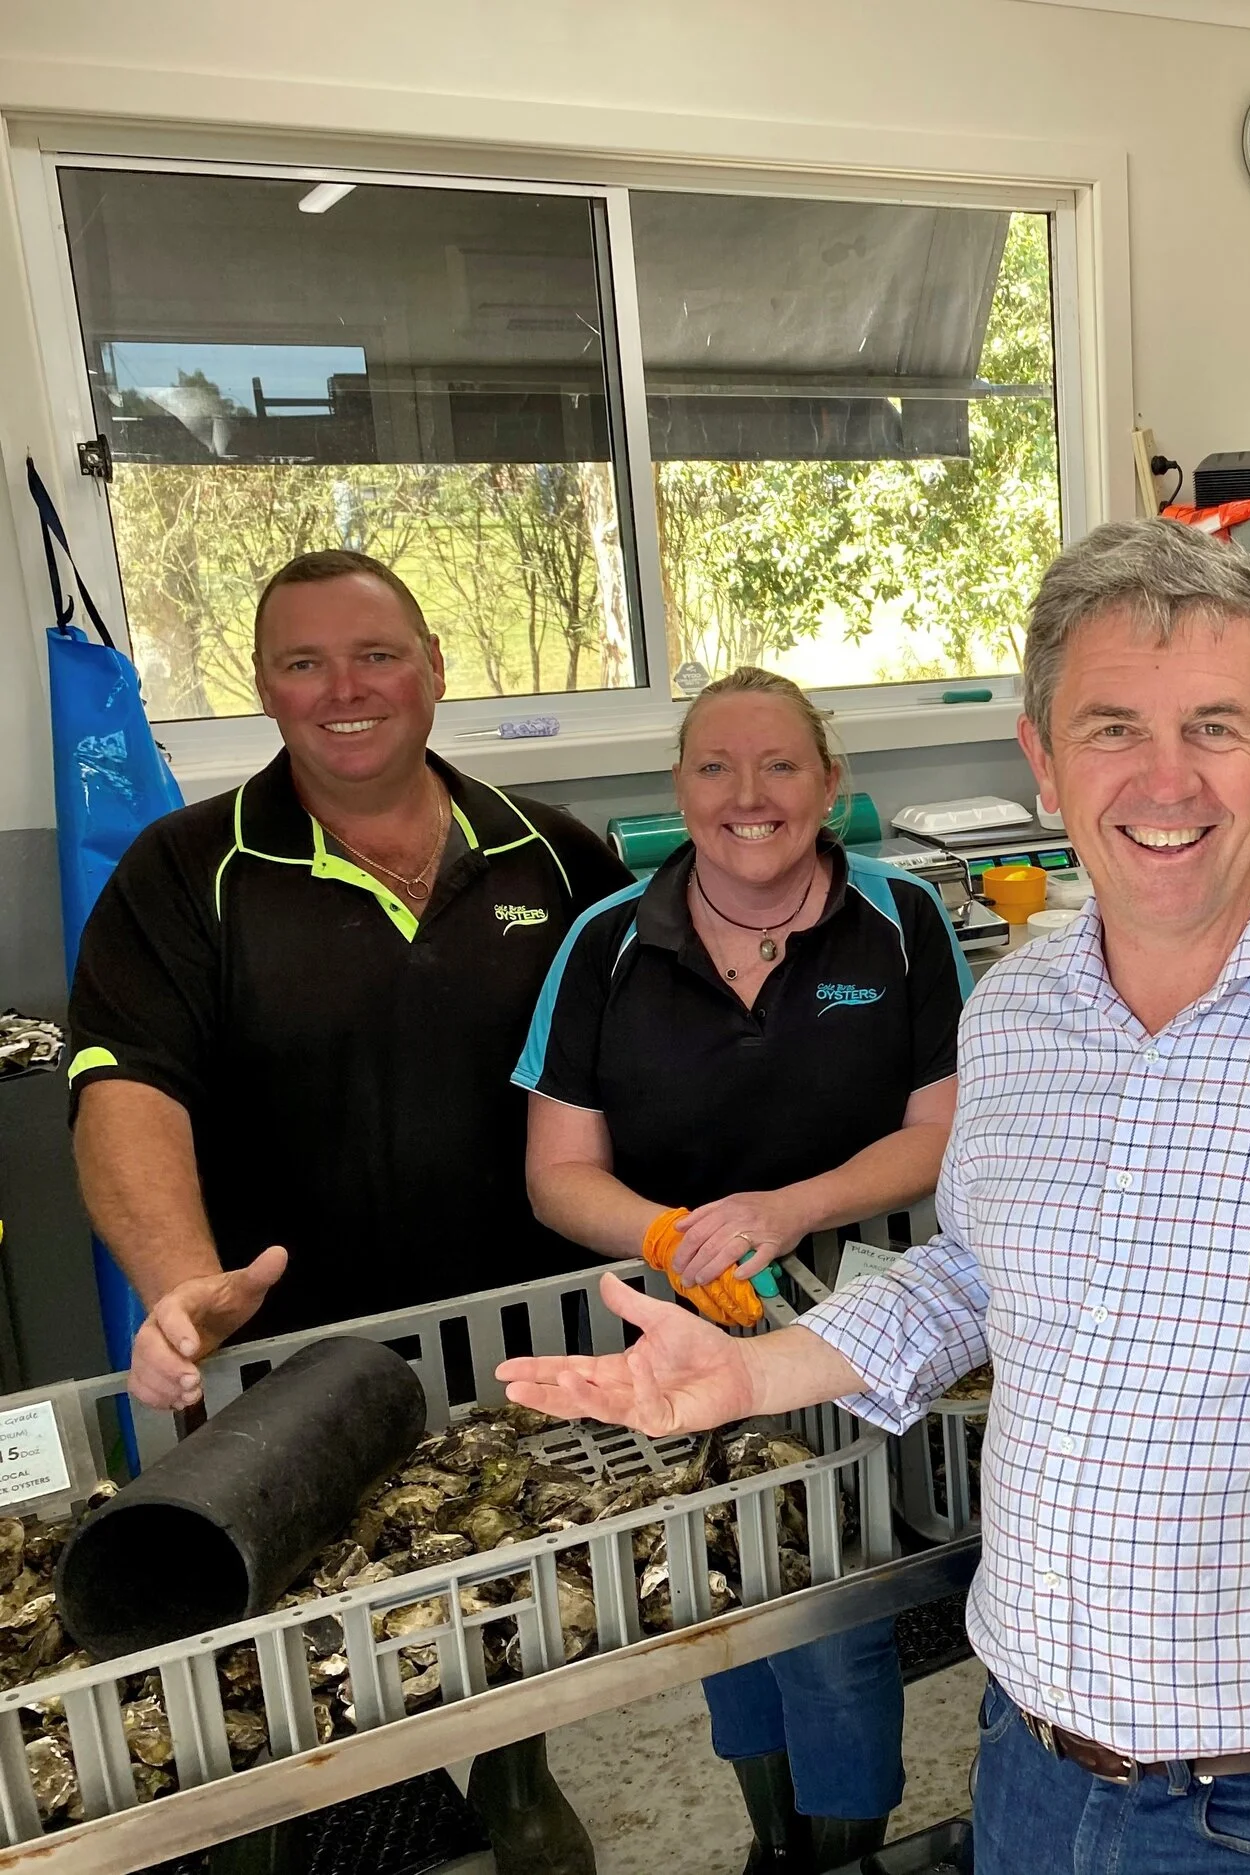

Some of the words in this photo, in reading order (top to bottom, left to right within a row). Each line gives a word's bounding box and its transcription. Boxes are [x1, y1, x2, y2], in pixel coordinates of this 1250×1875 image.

[495, 908, 546, 920] OYSTERS
[816, 988, 878, 1000] OYSTERS
[851, 1246, 875, 1257] Plate
[5, 1411, 39, 1425] Grade
[11, 1476, 51, 1492] OYSTERS
